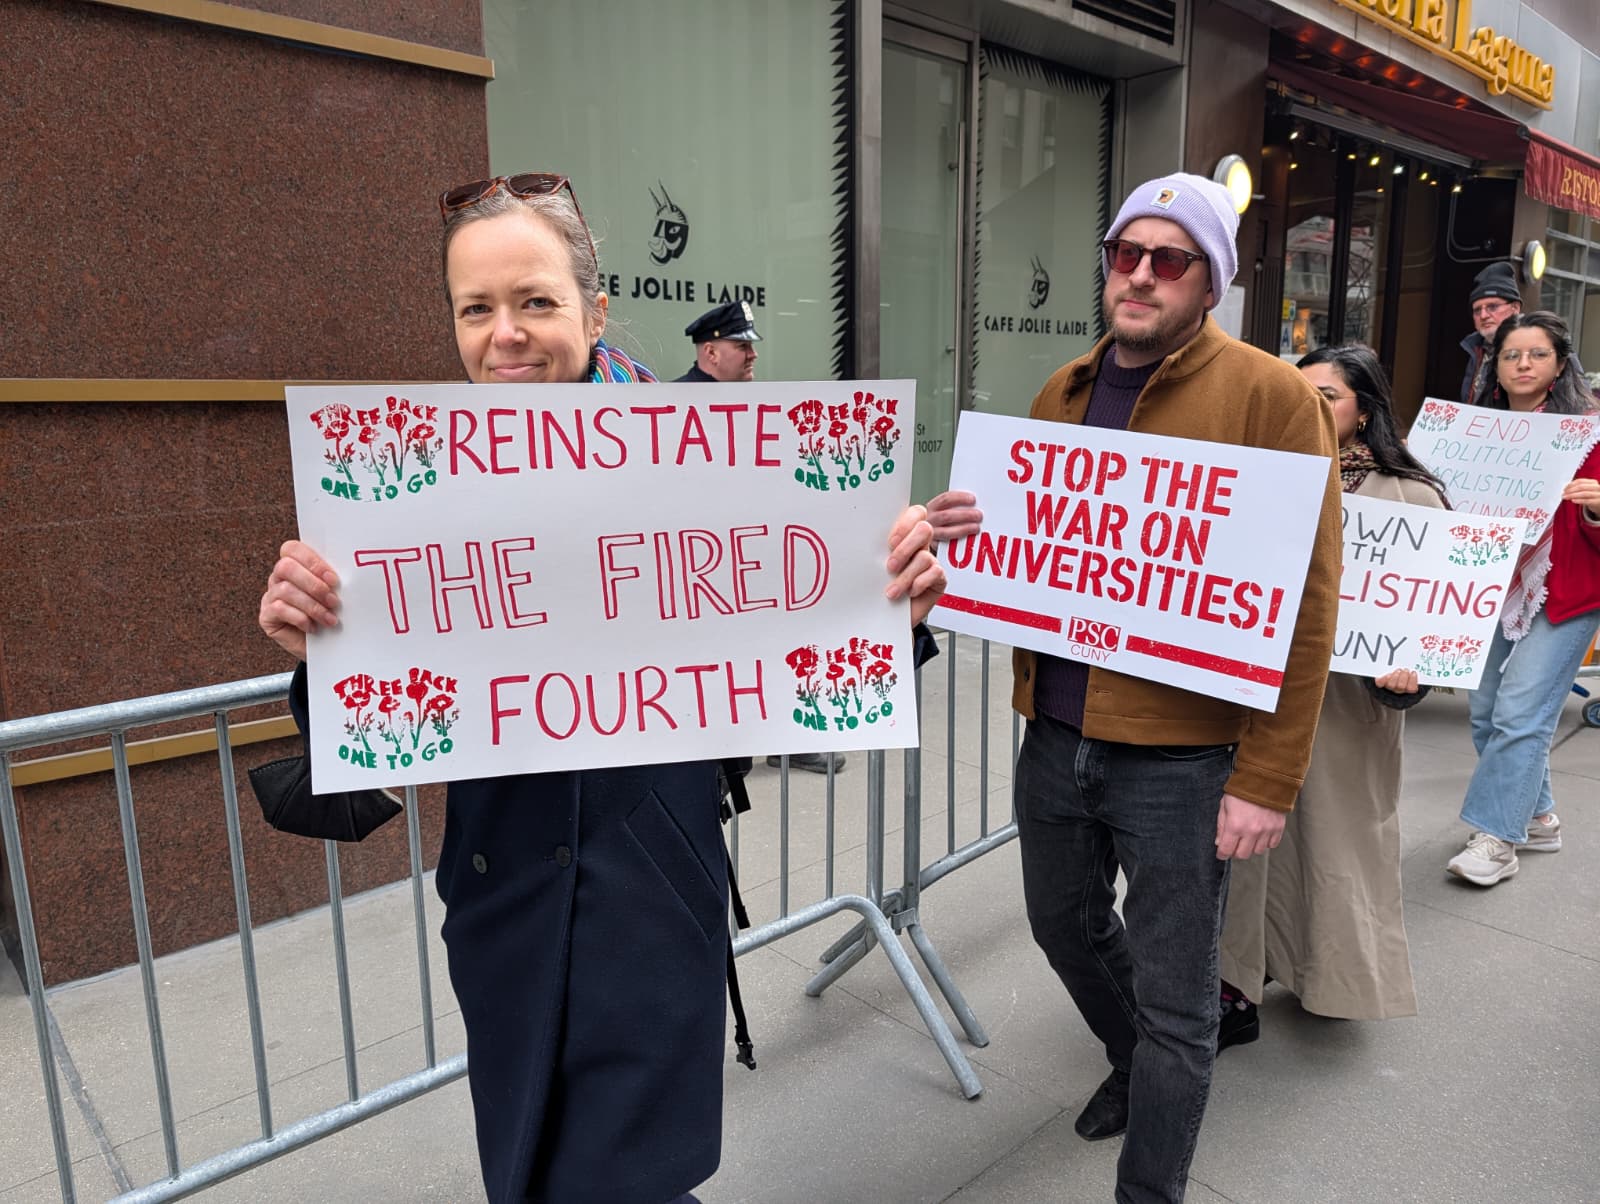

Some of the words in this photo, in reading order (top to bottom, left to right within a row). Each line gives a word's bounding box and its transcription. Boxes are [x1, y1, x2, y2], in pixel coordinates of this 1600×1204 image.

[1452, 0, 1554, 102] Laguna
[1561, 166, 1600, 208] RISTO
[597, 273, 620, 297] FE
[631, 276, 695, 302] JOLIE
[707, 282, 766, 307] LAIDE
[984, 315, 1013, 332] CAFE
[1018, 318, 1051, 334] JOLIE
[1056, 320, 1088, 336] LAIDE
[386, 396, 438, 422] BACK
[449, 404, 782, 475] REINSTATE
[916, 423, 925, 436] St
[1465, 415, 1531, 443] END
[918, 440, 942, 453] 10017
[1432, 438, 1544, 472] POLITICAL
[320, 476, 362, 501] ONE
[371, 484, 399, 502] TO
[407, 469, 437, 494] GO
[794, 467, 830, 492] ONE
[836, 474, 860, 492] TO
[867, 458, 895, 482] GO
[1006, 439, 1128, 497] STOP
[1140, 456, 1239, 517] THE
[1431, 466, 1545, 501] ACKLISTING
[1025, 491, 1129, 551] WAR
[1139, 510, 1212, 565] ON
[1449, 524, 1485, 536] THREE
[1343, 541, 1387, 565] TH
[1491, 554, 1509, 564] GO
[354, 537, 548, 634] THE
[598, 524, 830, 620] FIRED
[947, 532, 1286, 639] UNIVERSITIES!
[1339, 566, 1502, 618] LISTING
[1068, 617, 1119, 651] PSC
[1332, 630, 1408, 667] UNY
[1071, 643, 1112, 664] CUNY
[332, 673, 403, 700] THREE
[408, 667, 458, 694] BACK
[1454, 666, 1473, 677] GO
[490, 659, 768, 746] FOURTH
[834, 715, 859, 731] TO
[864, 701, 893, 724] GO
[338, 744, 378, 768] ONE
[386, 752, 413, 770] TO
[422, 738, 453, 761] GO
